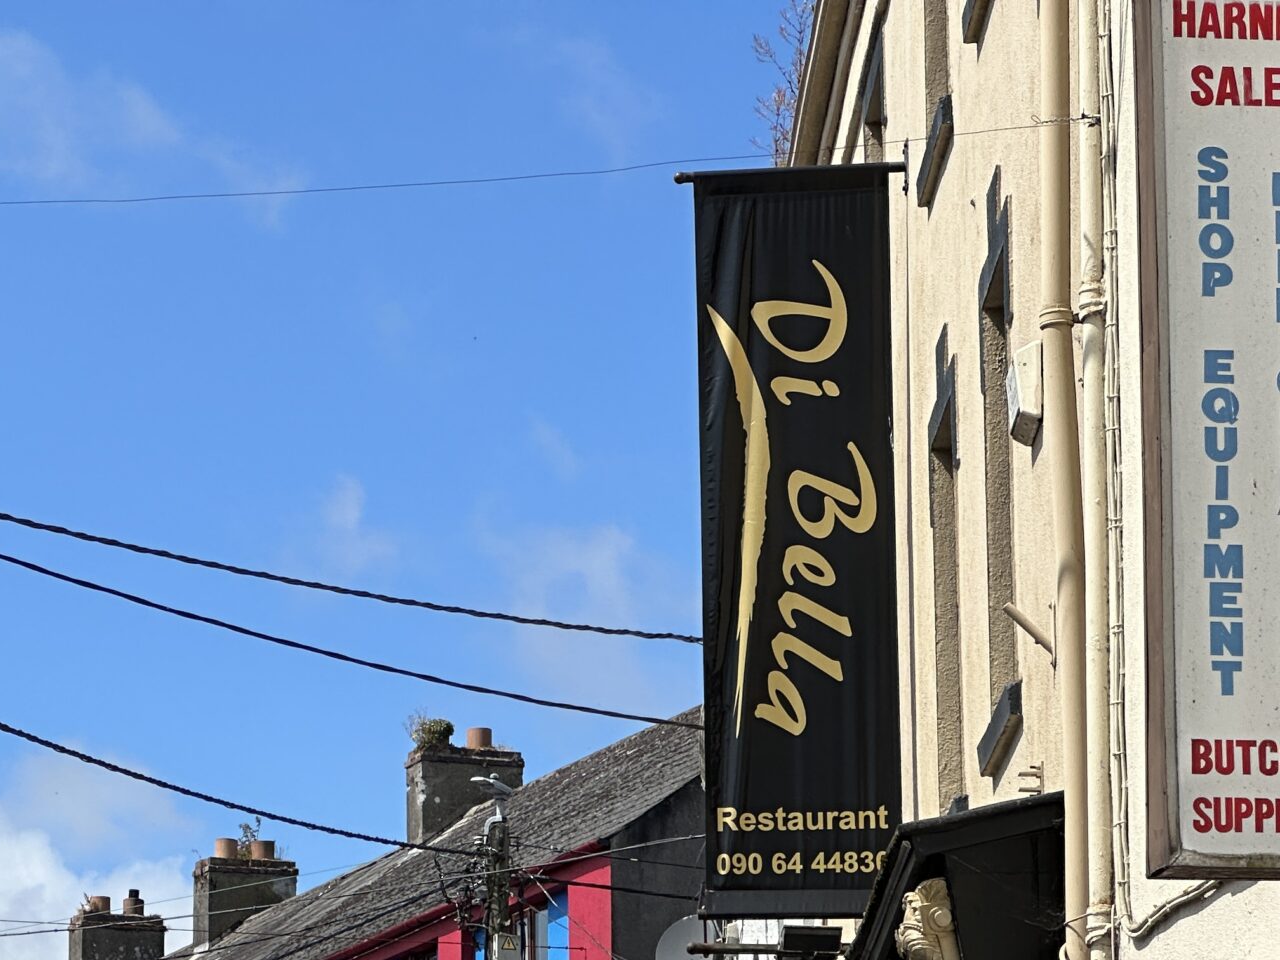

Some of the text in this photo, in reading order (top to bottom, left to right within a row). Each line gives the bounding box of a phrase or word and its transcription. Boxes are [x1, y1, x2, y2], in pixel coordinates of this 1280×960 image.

[1173, 0, 1280, 41] HARN
[1197, 146, 1244, 696] SHOP EQUIPMENT
[751, 259, 878, 736] Di Bella
[1191, 738, 1280, 776] BUTC
[716, 804, 889, 832] Restaurant
[716, 852, 763, 876] 090
[771, 852, 804, 874] 64
